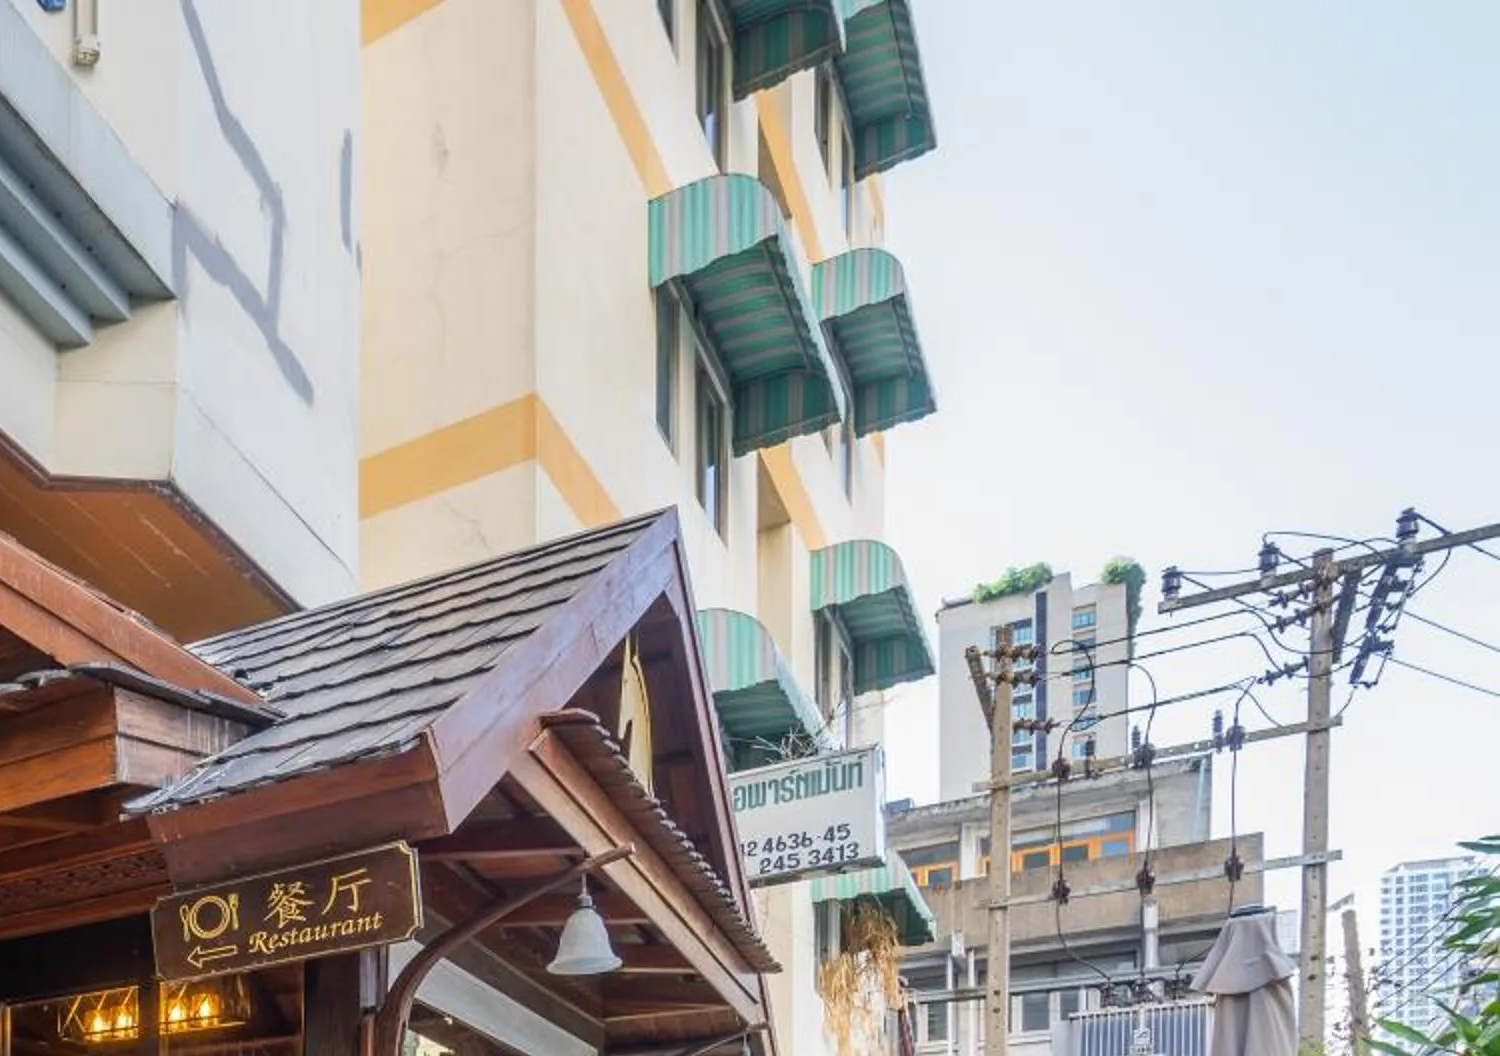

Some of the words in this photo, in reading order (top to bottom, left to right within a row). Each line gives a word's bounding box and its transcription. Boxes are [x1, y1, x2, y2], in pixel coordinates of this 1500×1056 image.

[759, 853, 801, 875] 245
[808, 842, 859, 866] 3413
[263, 867, 373, 929] 餐厅
[248, 911, 384, 954] Restaurant
